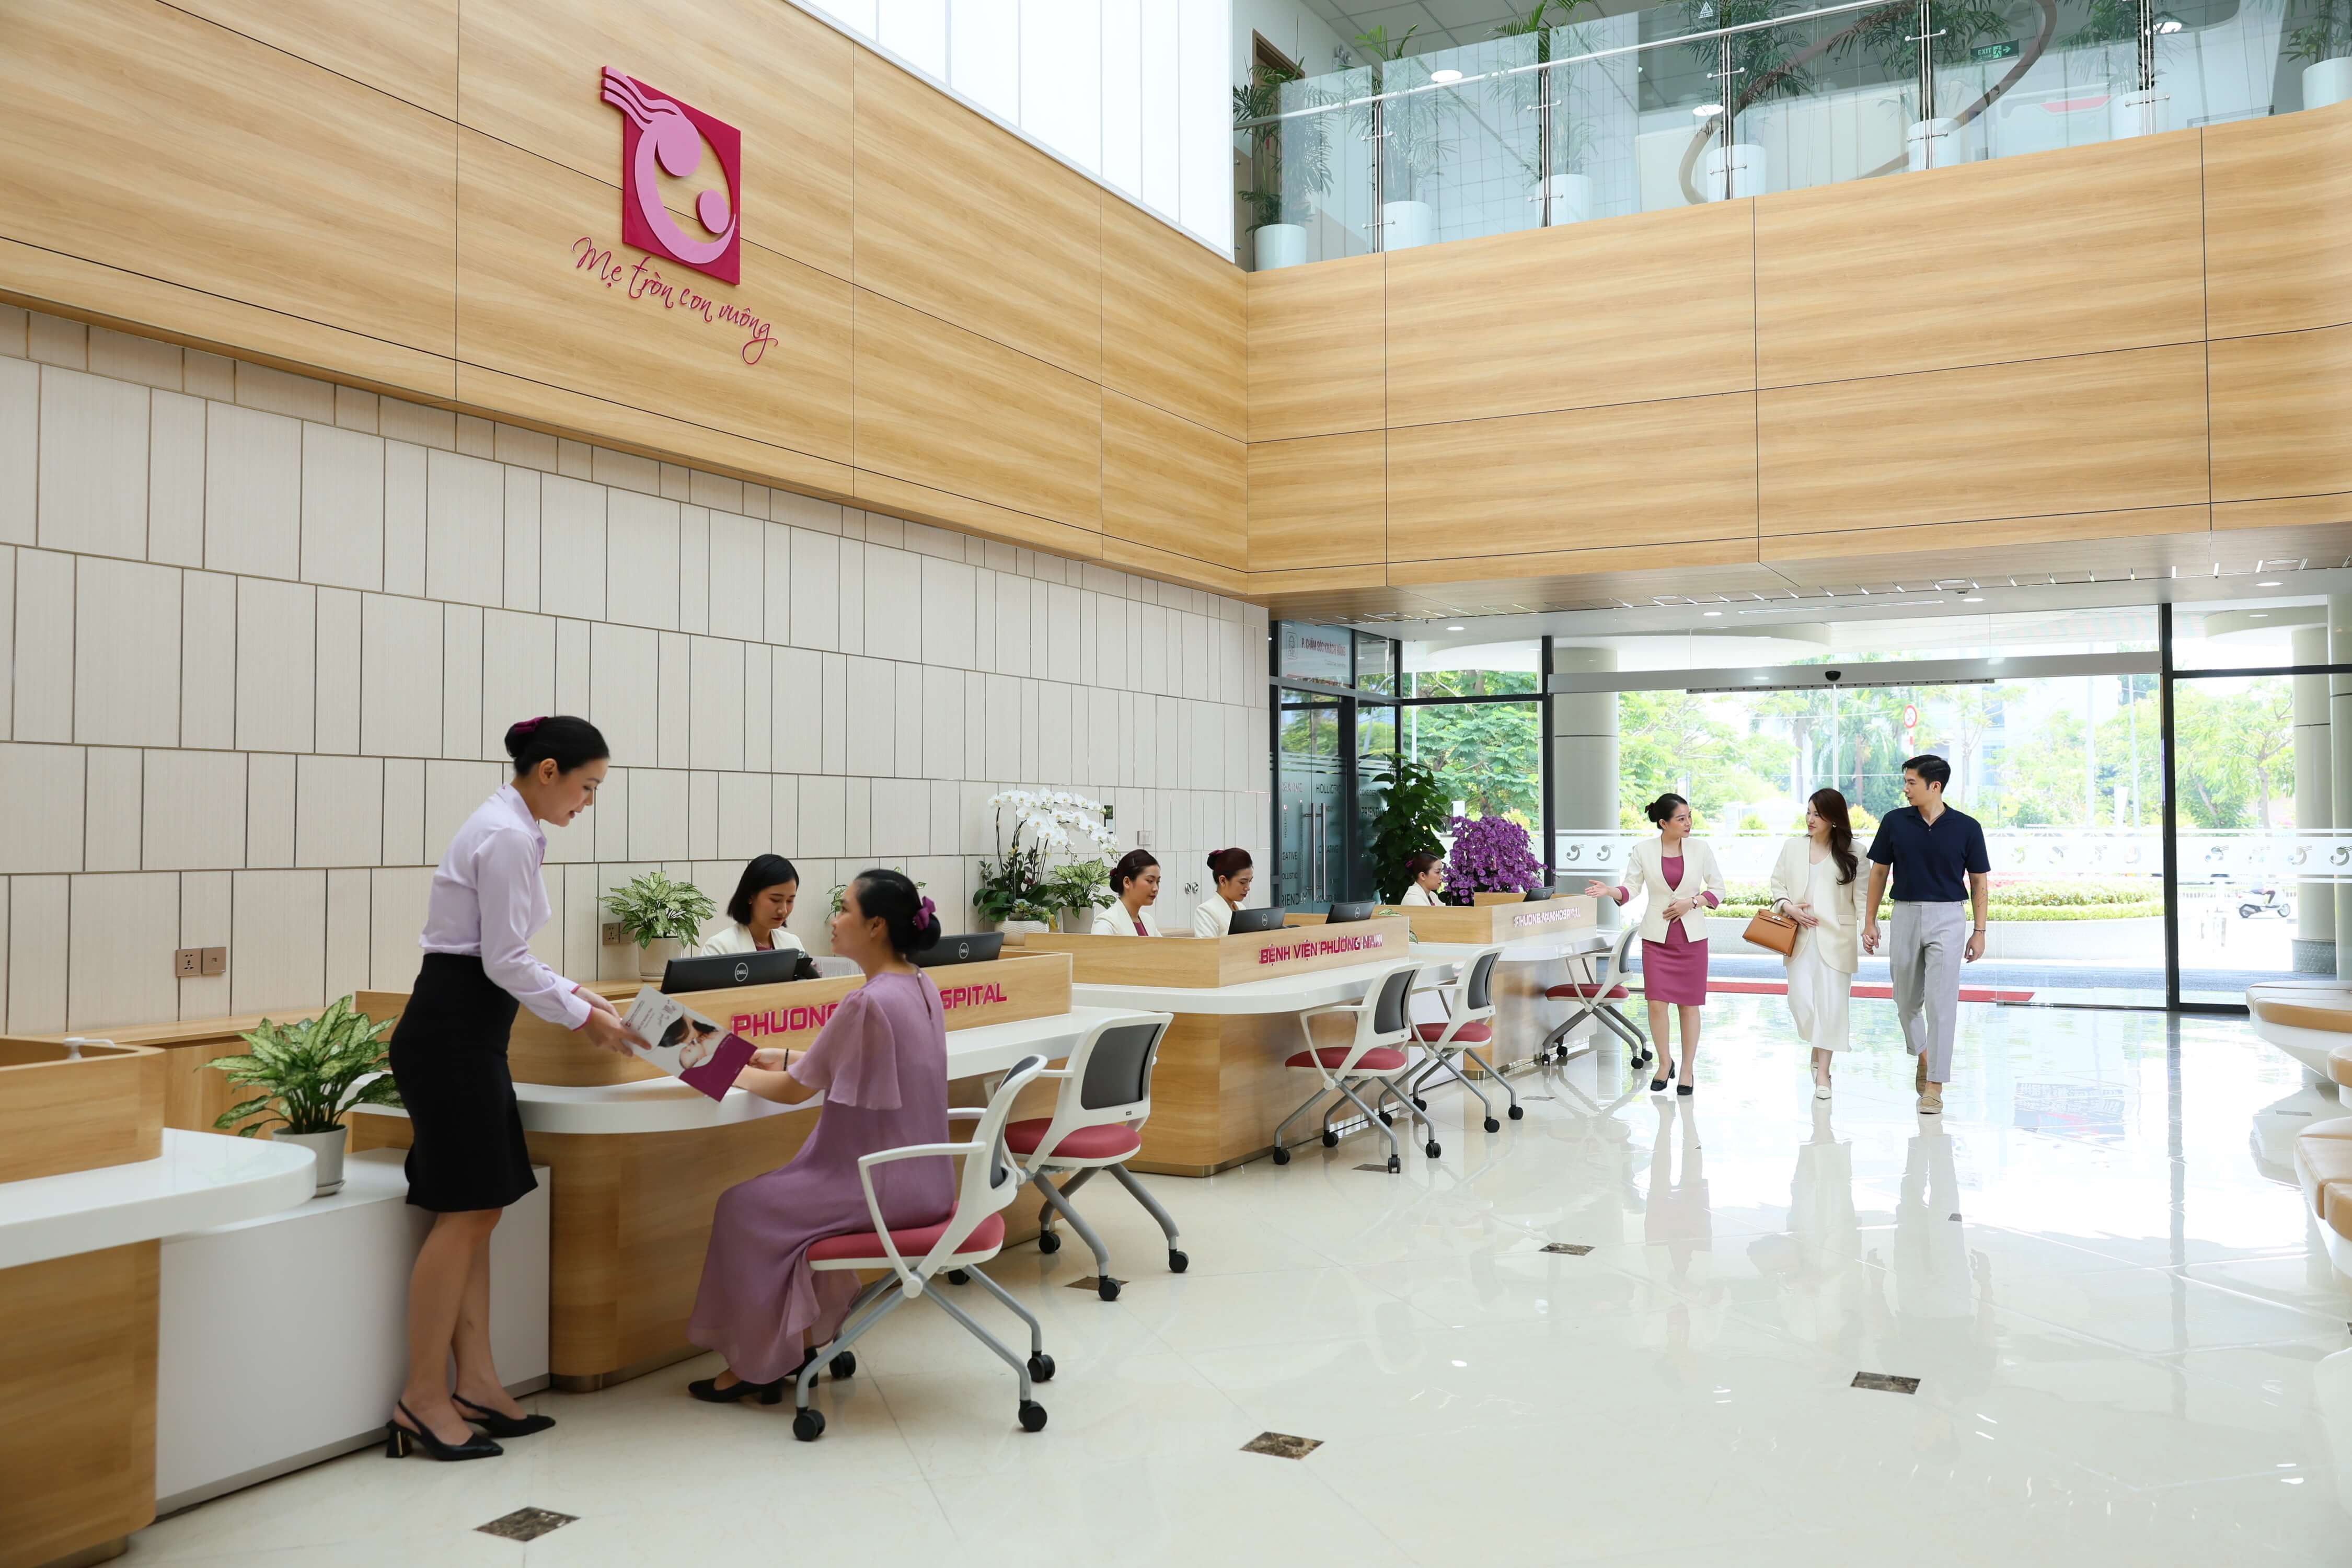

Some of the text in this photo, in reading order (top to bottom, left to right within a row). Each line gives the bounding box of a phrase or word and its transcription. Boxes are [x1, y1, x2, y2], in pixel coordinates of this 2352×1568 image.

[571, 237, 778, 365] Mẹ tròn con vuông
[1282, 892, 1307, 907] RIENDLY
[1259, 943, 1290, 966] BỆNH
[1293, 939, 1318, 961] VIỆN
[1361, 933, 1383, 950] NAM
[939, 983, 1008, 1009] SPITAL
